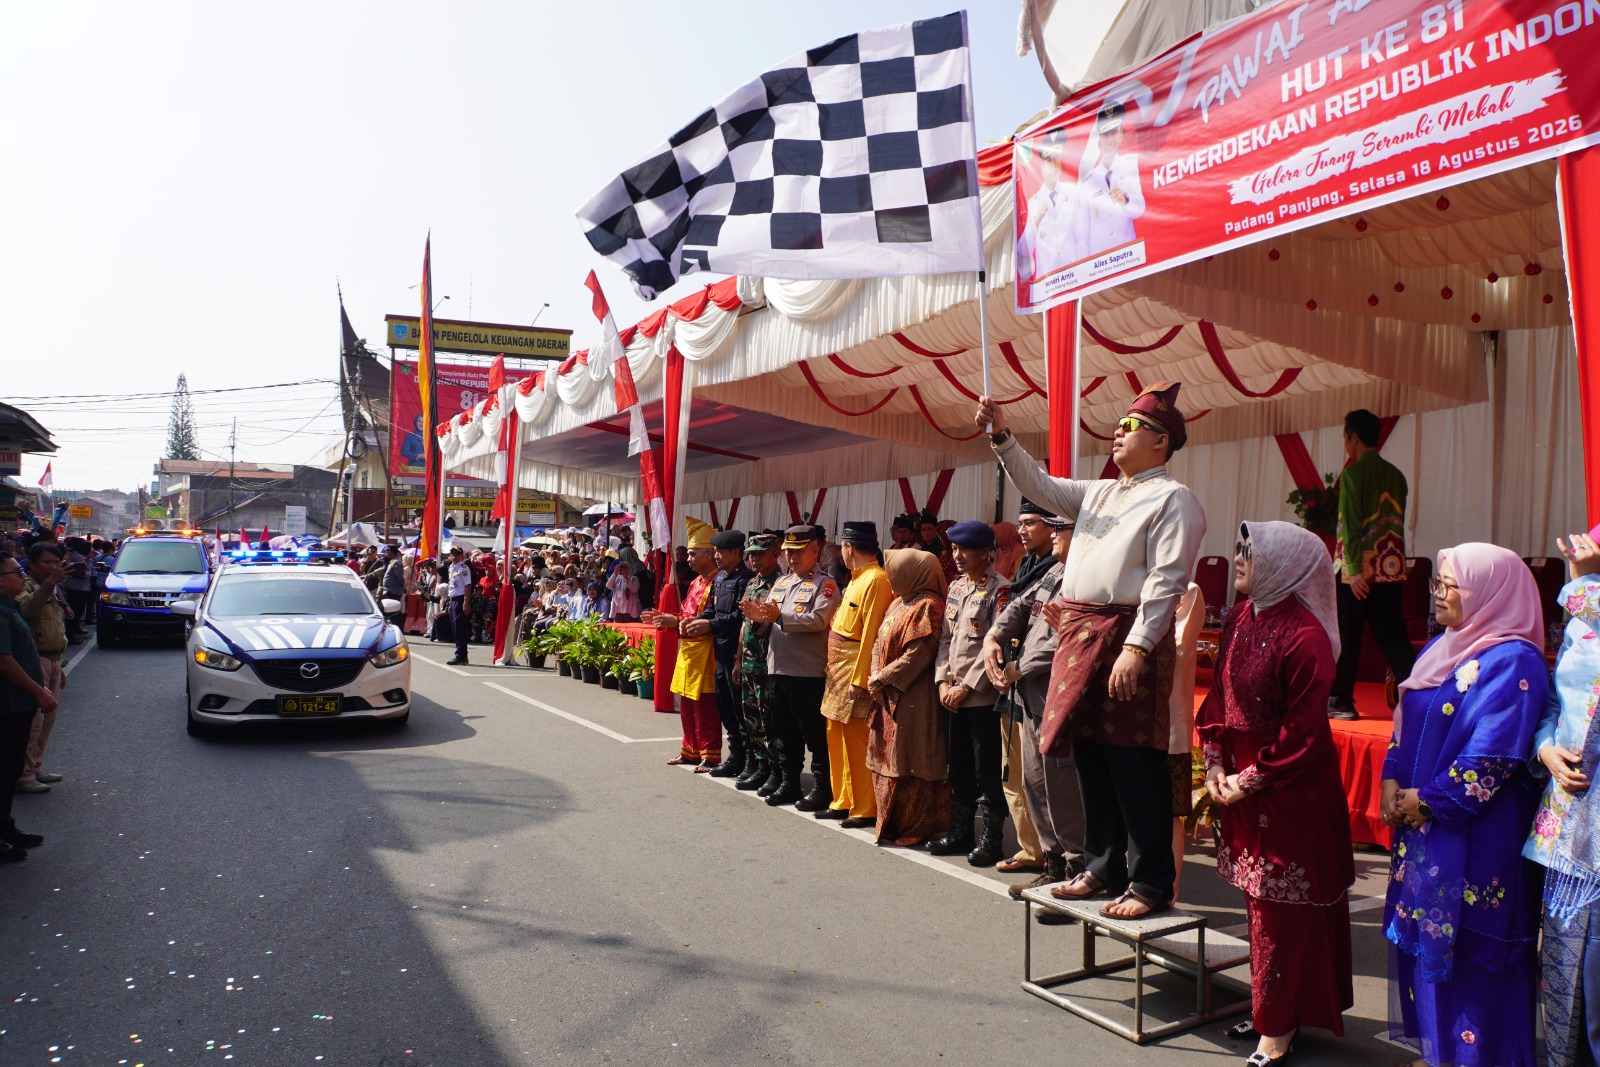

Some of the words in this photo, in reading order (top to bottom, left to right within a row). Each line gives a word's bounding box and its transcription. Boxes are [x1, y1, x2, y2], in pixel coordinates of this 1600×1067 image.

[1193, 2, 1309, 124] PAWAI
[1281, 46, 1349, 103] HUT
[1360, 20, 1409, 70] KE
[1421, 0, 1464, 44] 81
[1153, 108, 1317, 189] KEMERDEKAAN
[1324, 41, 1476, 123] REPUBLIK
[1305, 147, 1358, 172] Juang
[1362, 113, 1435, 157] Serambi
[1225, 210, 1275, 235] Padang
[1278, 190, 1344, 218] Panjang,
[1349, 171, 1406, 197] Selasa
[1411, 160, 1431, 177] 18
[1438, 136, 1520, 171] Agustus
[1527, 114, 1583, 144] 2026
[1060, 270, 1075, 282] Arnis
[1109, 250, 1133, 264] Saputra
[441, 330, 489, 344] PENGELOLA
[491, 334, 535, 348] KEUANGAN
[536, 338, 568, 350] DAERAH
[232, 617, 369, 627] POLISI
